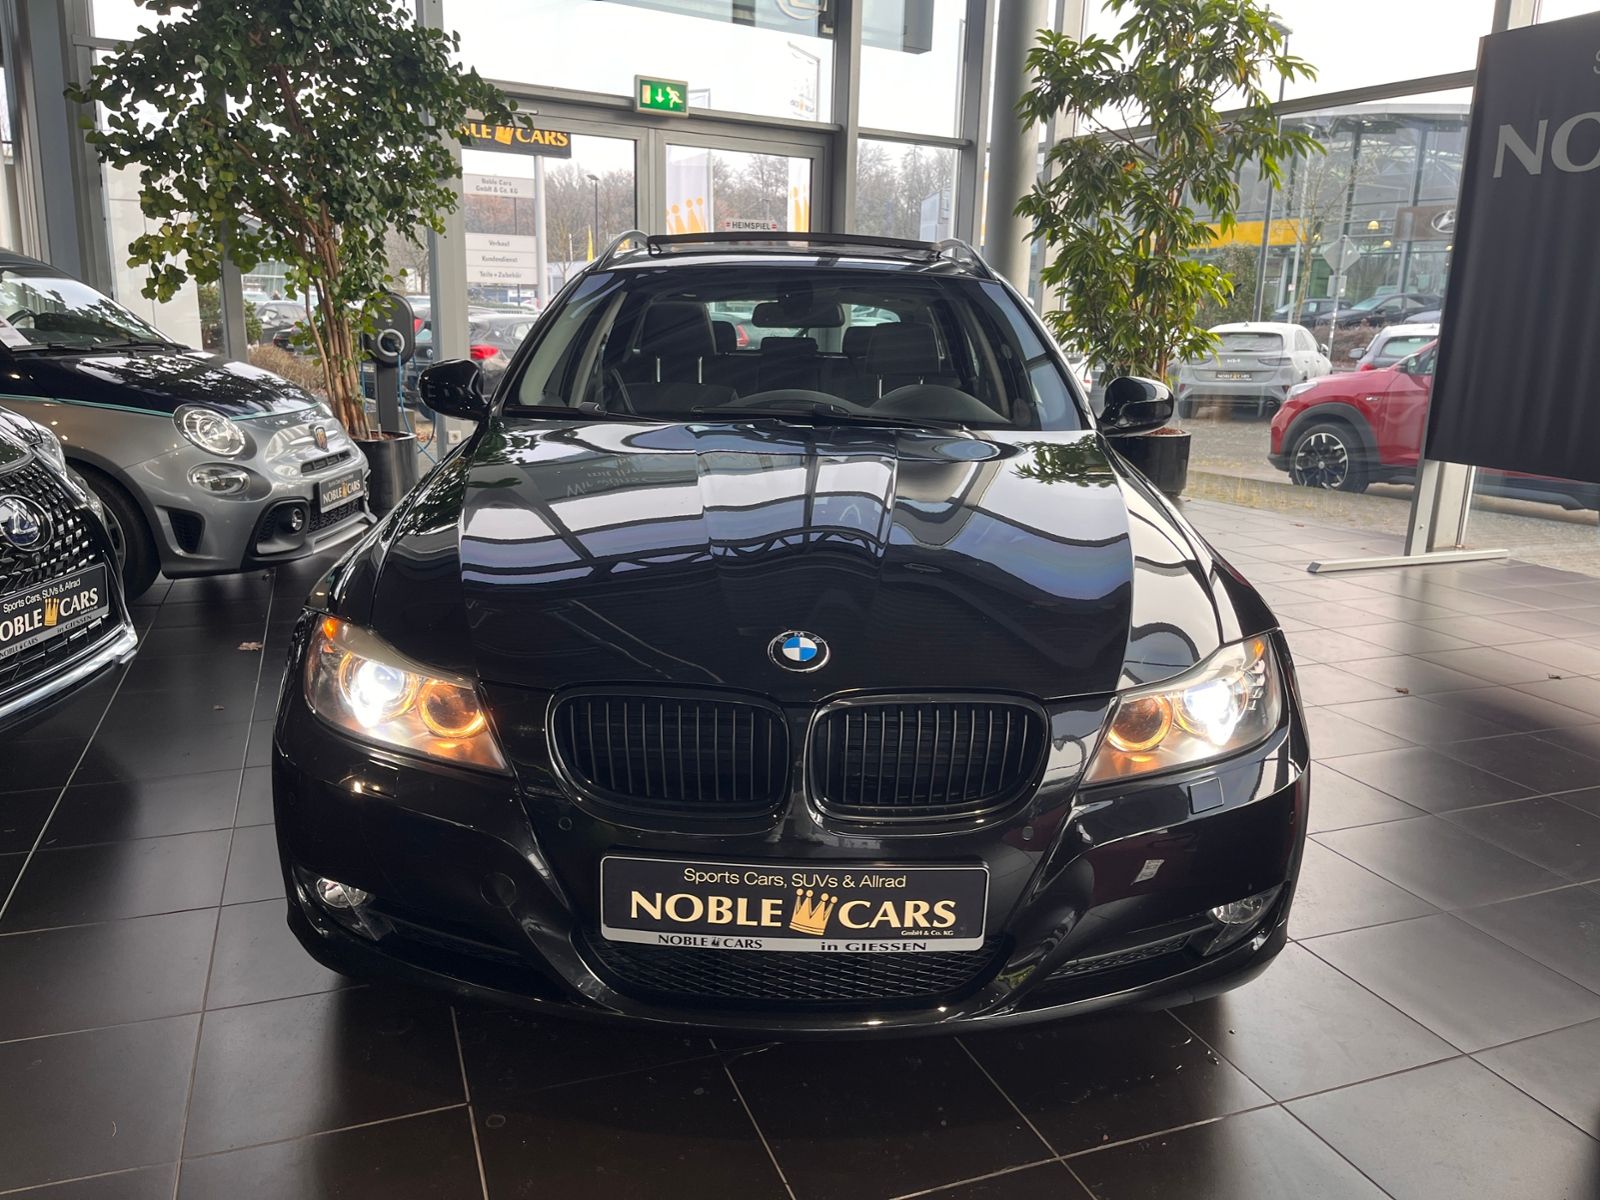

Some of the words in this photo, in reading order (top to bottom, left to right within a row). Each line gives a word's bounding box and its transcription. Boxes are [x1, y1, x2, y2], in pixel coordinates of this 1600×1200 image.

[515, 128, 569, 147] CARS
[732, 221, 770, 230] HEIMSPIEL
[323, 486, 342, 505] NOBLE
[347, 479, 361, 494] CARS
[3, 598, 25, 614] Sports
[42, 585, 59, 599] SUVs
[59, 584, 65, 593] &
[60, 587, 99, 617] CARS
[684, 868, 740, 885] Sports
[744, 871, 787, 889] Cars,
[791, 873, 839, 888] SUVs
[842, 875, 855, 888] &
[859, 875, 907, 888] Allrad
[630, 890, 783, 928] NOBLE
[838, 900, 956, 929] CARS
[658, 934, 708, 948] NOBLE
[723, 937, 763, 949] CARS
[821, 941, 838, 951] in
[845, 942, 927, 951] GIESSEN
